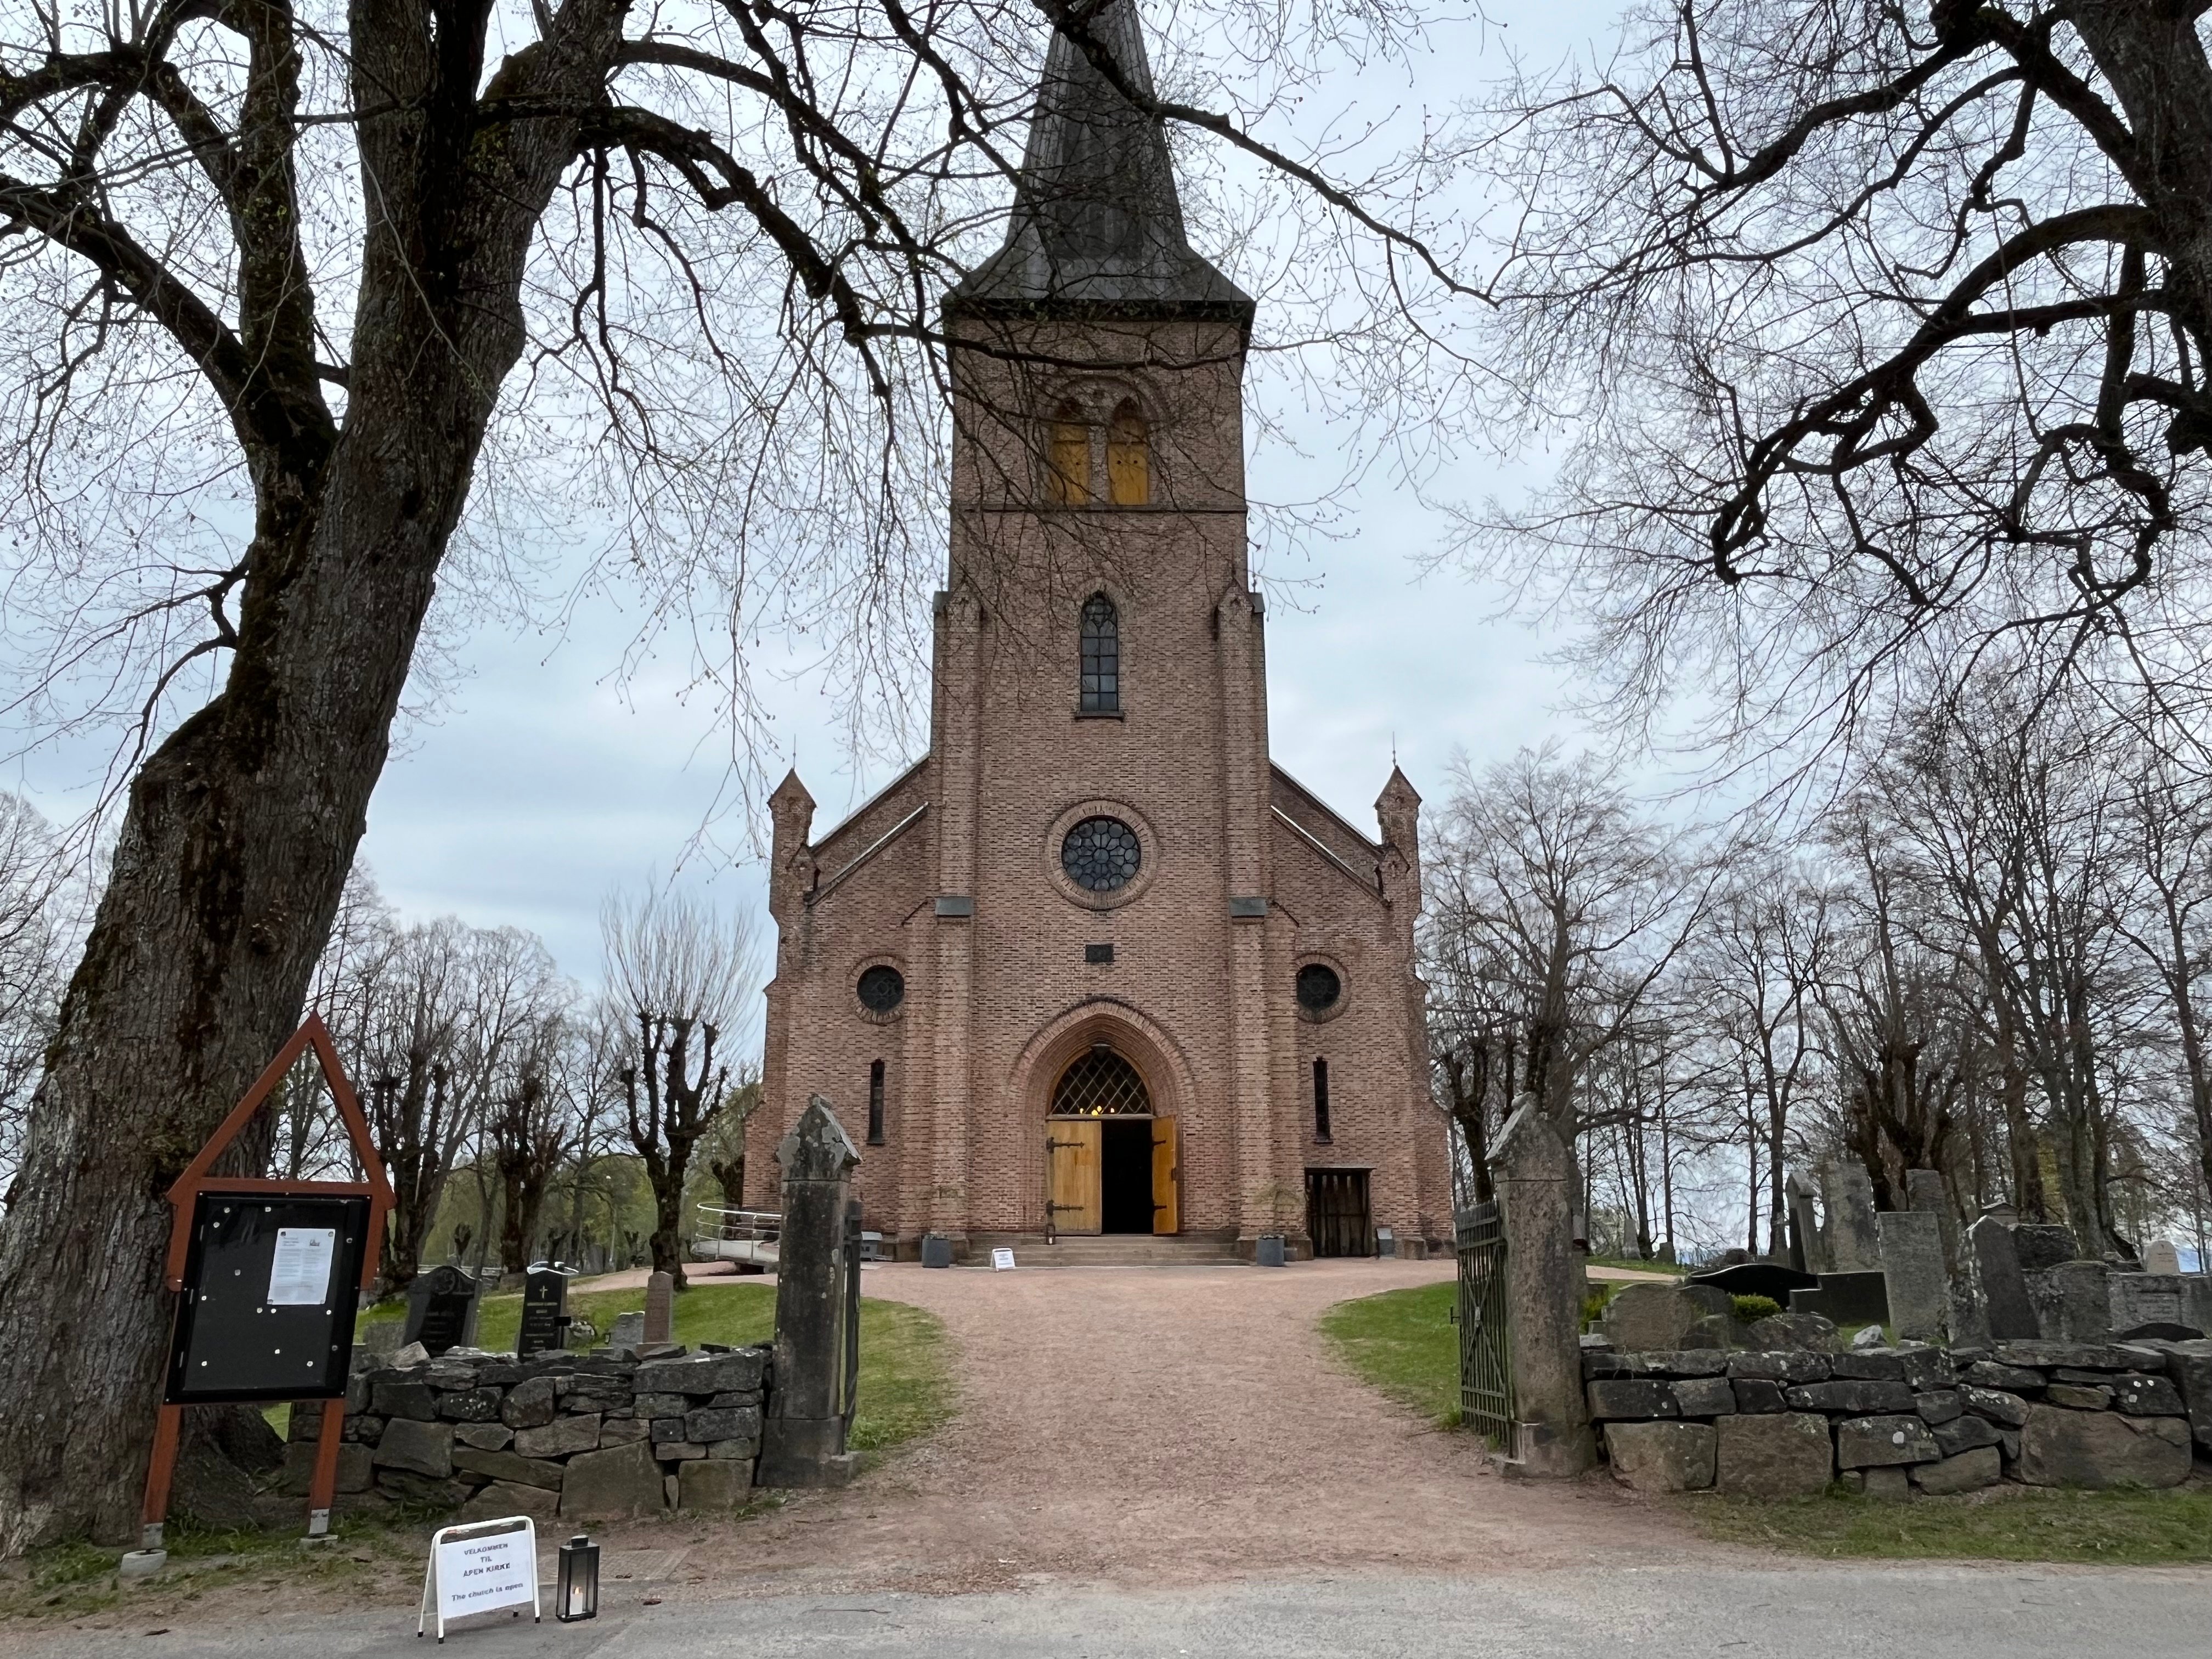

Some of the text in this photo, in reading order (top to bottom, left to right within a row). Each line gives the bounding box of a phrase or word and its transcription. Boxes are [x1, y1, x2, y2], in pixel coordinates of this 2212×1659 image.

[464, 1543, 508, 1555] VELKOMMEN
[486, 1562, 510, 1572] KIRKE
[468, 1588, 494, 1598] church
